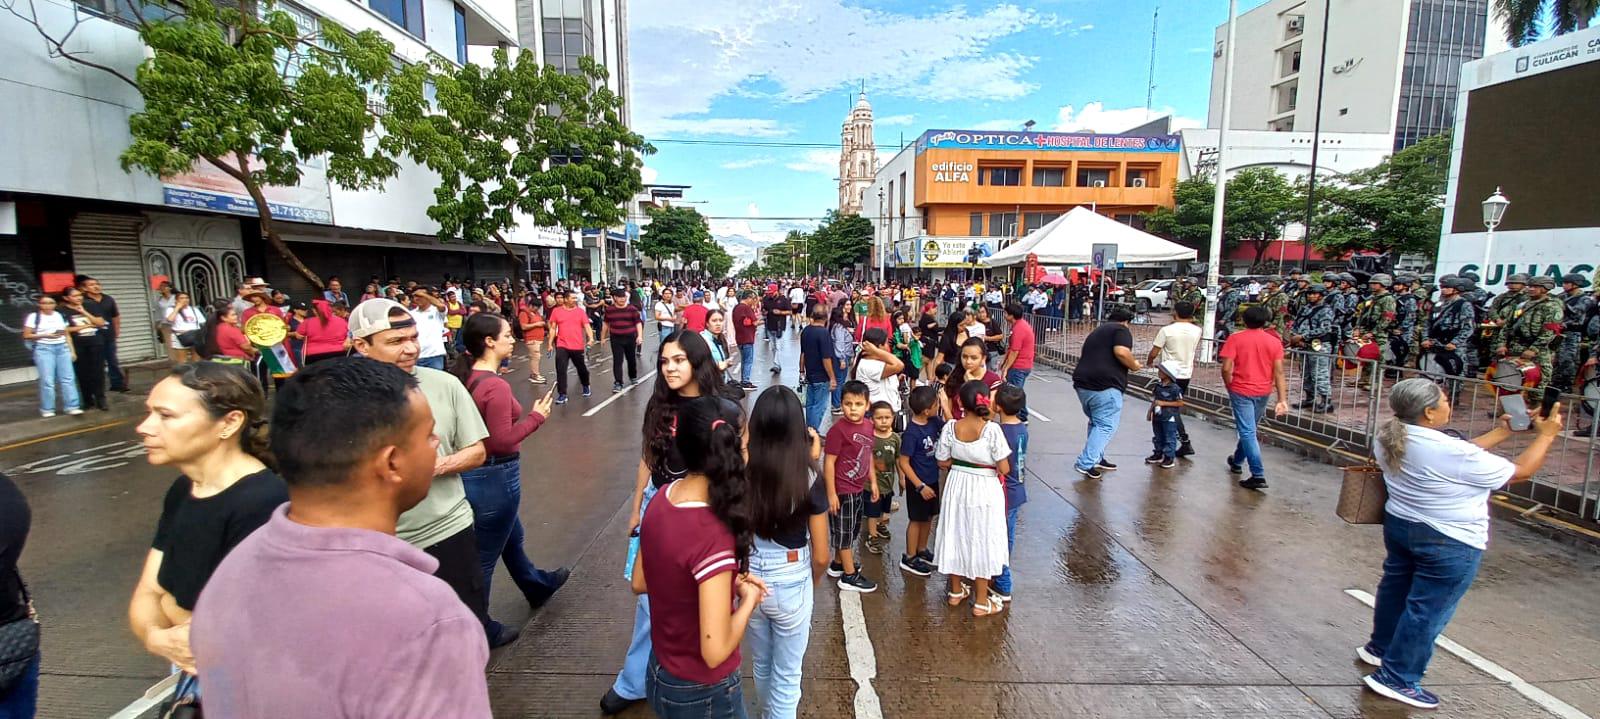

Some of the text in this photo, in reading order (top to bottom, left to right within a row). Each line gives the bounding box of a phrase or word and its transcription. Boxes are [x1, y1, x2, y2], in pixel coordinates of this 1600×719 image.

[956, 133, 1034, 146] OPTICA
[1047, 136, 1092, 148] HOSPITAL
[1094, 137, 1108, 148] DE
[1109, 137, 1146, 149] LENTES
[931, 161, 973, 172] edificio
[934, 171, 970, 183] ALFA
